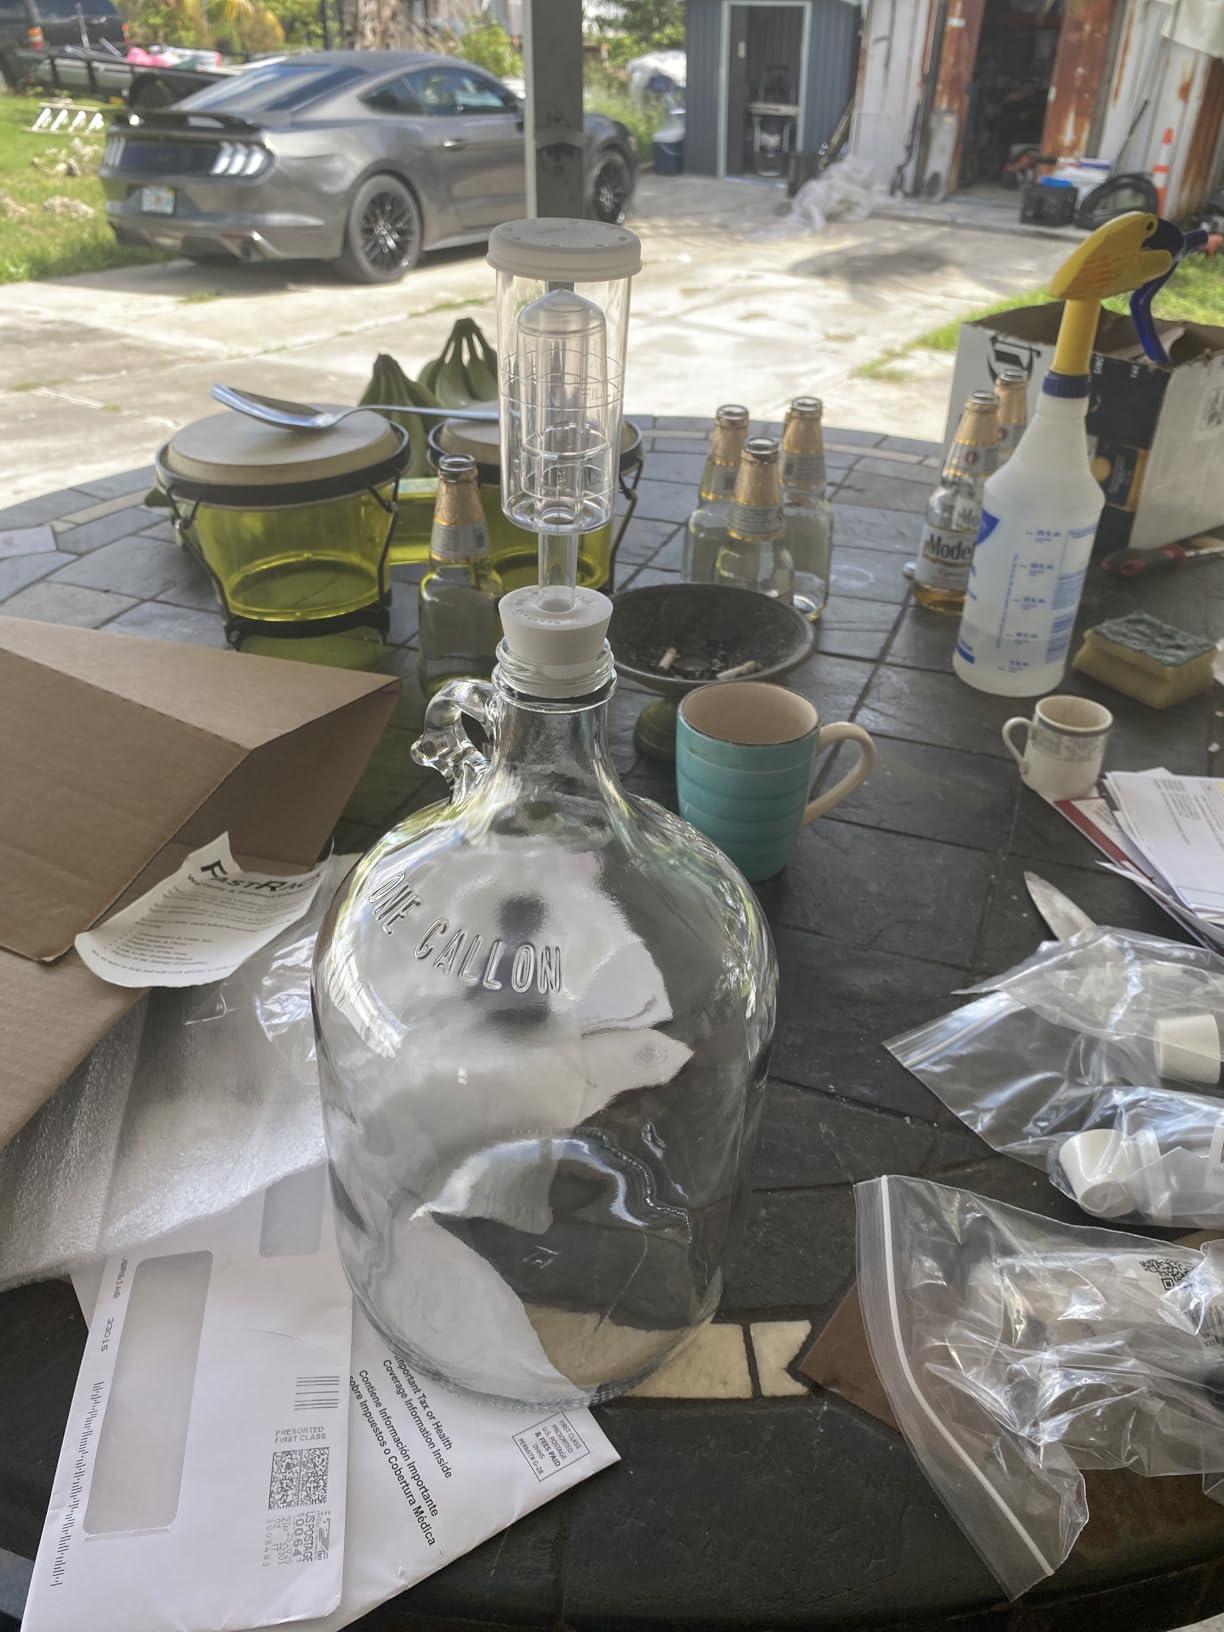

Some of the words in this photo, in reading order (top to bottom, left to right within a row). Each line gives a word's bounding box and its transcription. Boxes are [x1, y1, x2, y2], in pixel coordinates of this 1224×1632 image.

[369, 871, 422, 935] ONE
[414, 918, 562, 994] GALLON
[394, 1355, 422, 1395] mportant
[417, 1393, 430, 1411] Tax
[426, 1410, 437, 1421] or
[432, 1421, 453, 1450] Health
[275, 1426, 324, 1437] PRESORTED
[383, 1359, 408, 1399] Coverage
[404, 1398, 437, 1449] Information
[432, 1448, 452, 1479] Inside
[559, 1419, 571, 1433] FIRST
[568, 1432, 582, 1450] CLASS
[274, 1435, 298, 1444] FIRST
[300, 1433, 326, 1442] CLASS
[359, 1370, 382, 1408] Contiene
[378, 1407, 411, 1461] Información
[406, 1461, 439, 1517] Importante
[539, 1437, 551, 1452] FEES
[548, 1451, 561, 1467] PAID
[549, 1435, 567, 1460] POSTAGE
[551, 1424, 574, 1453] PRESORTED
[360, 1400, 387, 1447] Impuestos
[388, 1455, 416, 1506] Cobertura
[412, 1505, 436, 1546] Médica
[305, 1511, 315, 1524] US
[303, 1523, 315, 1563] POSTAGE
